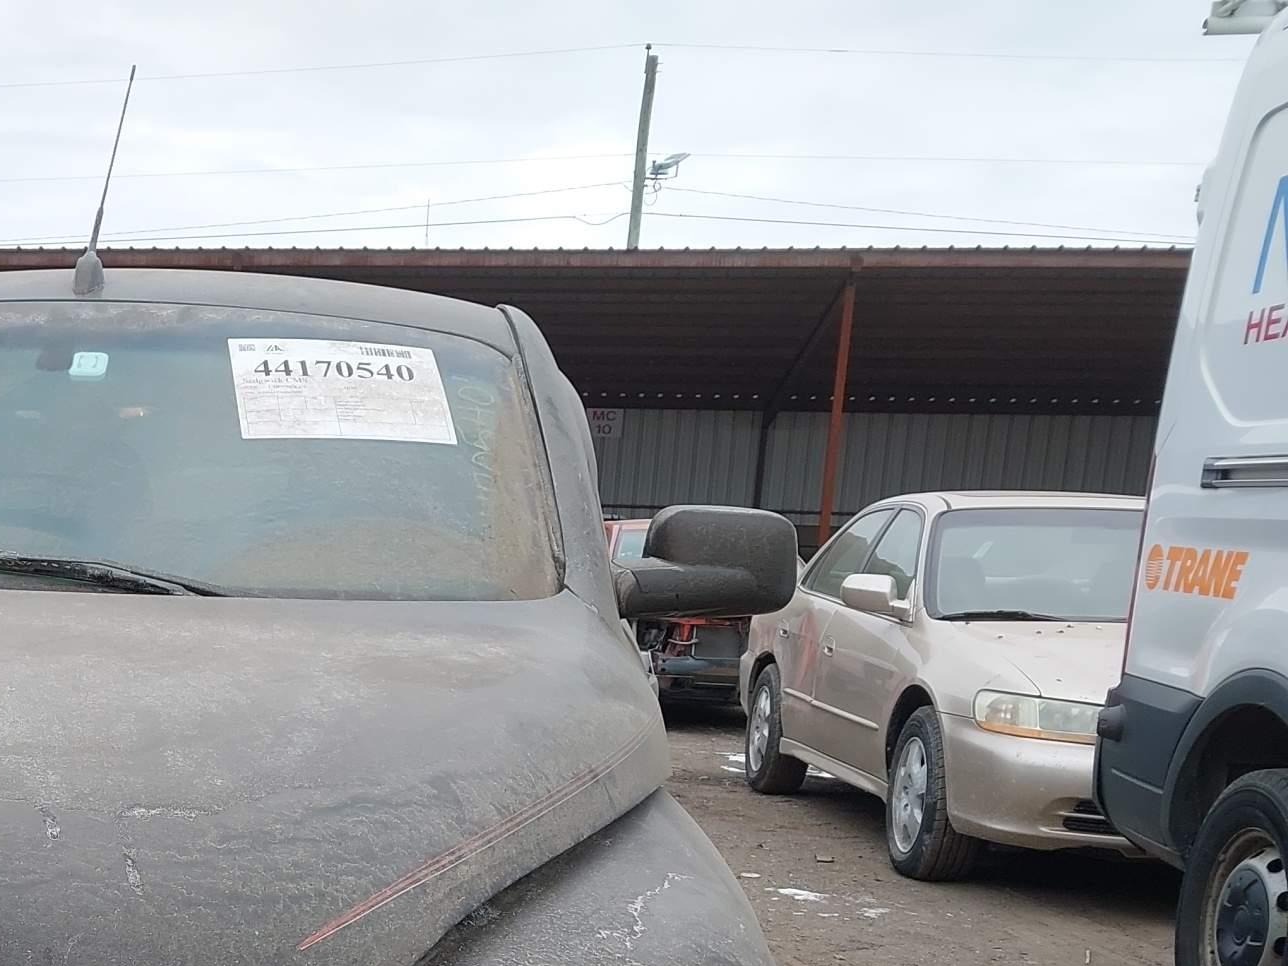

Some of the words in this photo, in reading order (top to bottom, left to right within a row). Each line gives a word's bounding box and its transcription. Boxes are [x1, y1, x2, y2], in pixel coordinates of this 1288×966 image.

[253, 359, 415, 382] 44170540
[592, 410, 617, 422] MC
[596, 424, 612, 435] 10
[1162, 545, 1250, 600] TRANE
